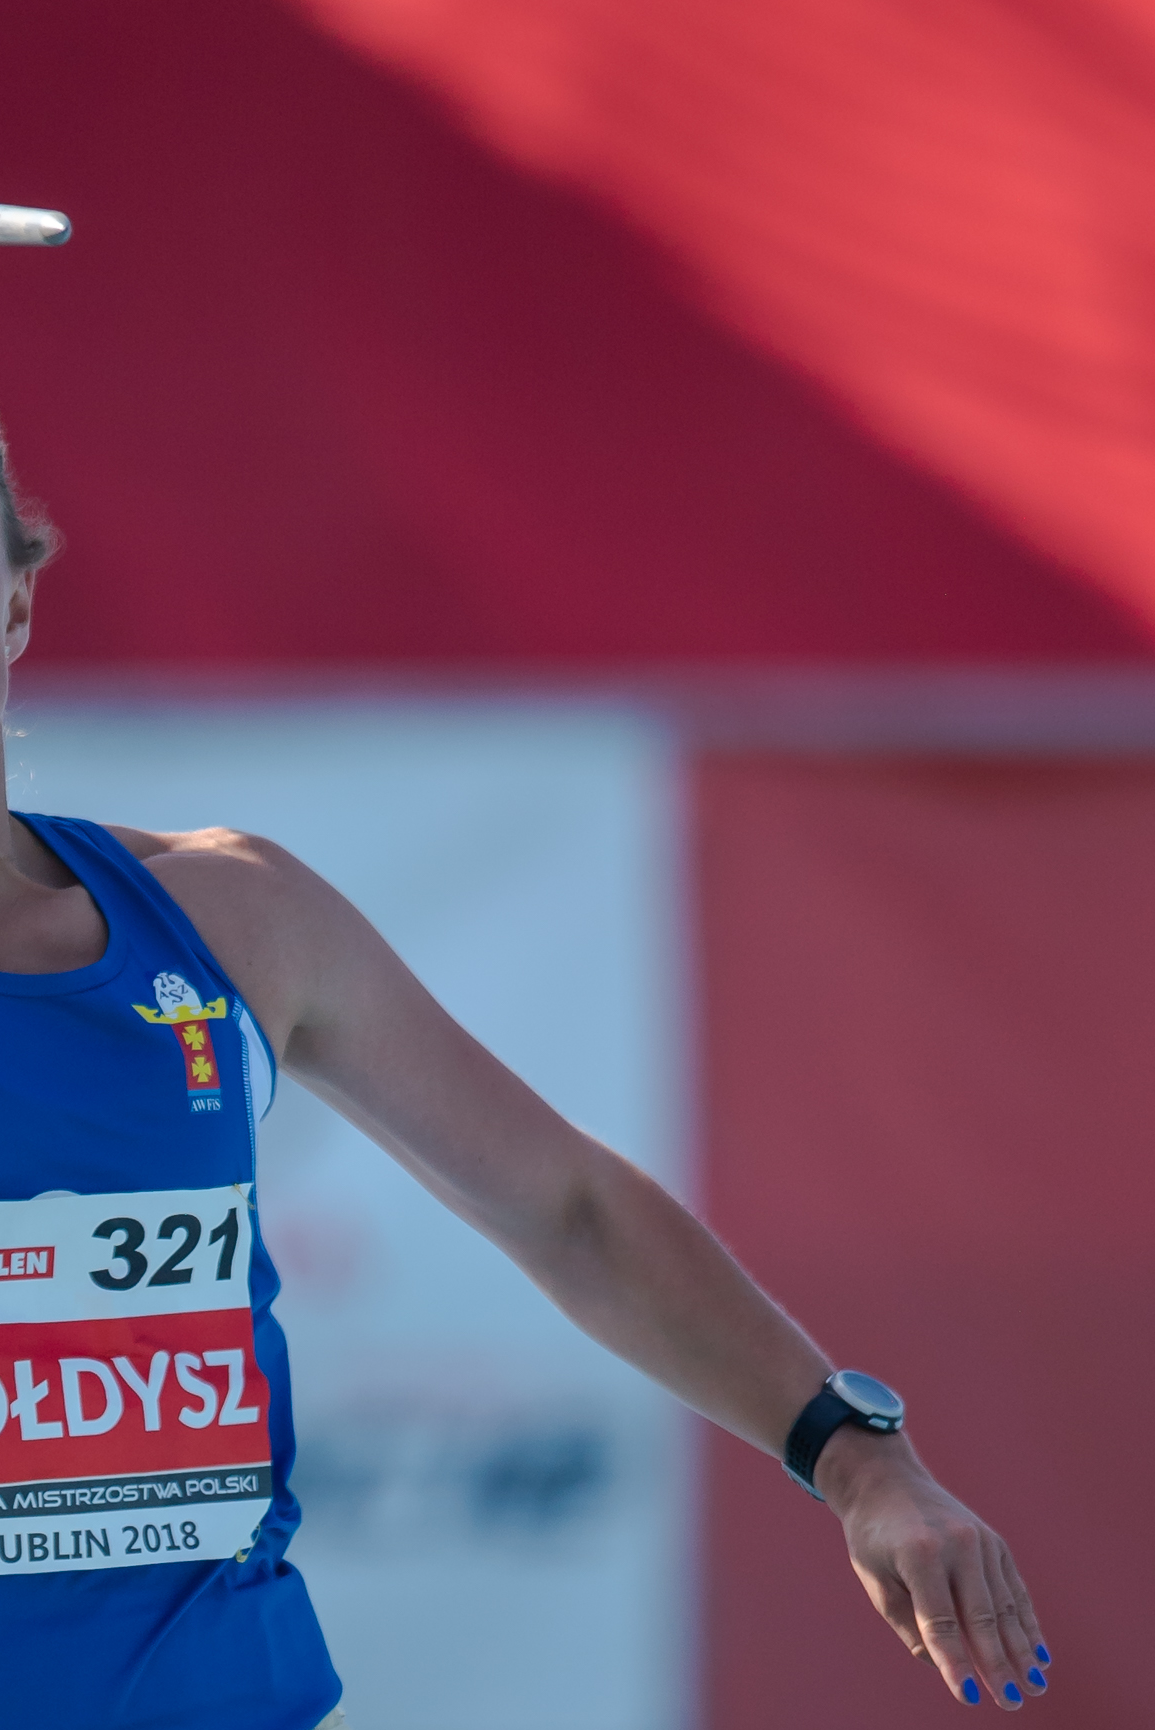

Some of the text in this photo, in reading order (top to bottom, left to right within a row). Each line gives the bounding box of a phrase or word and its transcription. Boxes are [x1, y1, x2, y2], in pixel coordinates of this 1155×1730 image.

[88, 1207, 239, 1291] 321
[12, 1481, 180, 1510] MISTRZOSTWA
[186, 1474, 259, 1496] POLSKI
[122, 1521, 201, 1555] 2018
